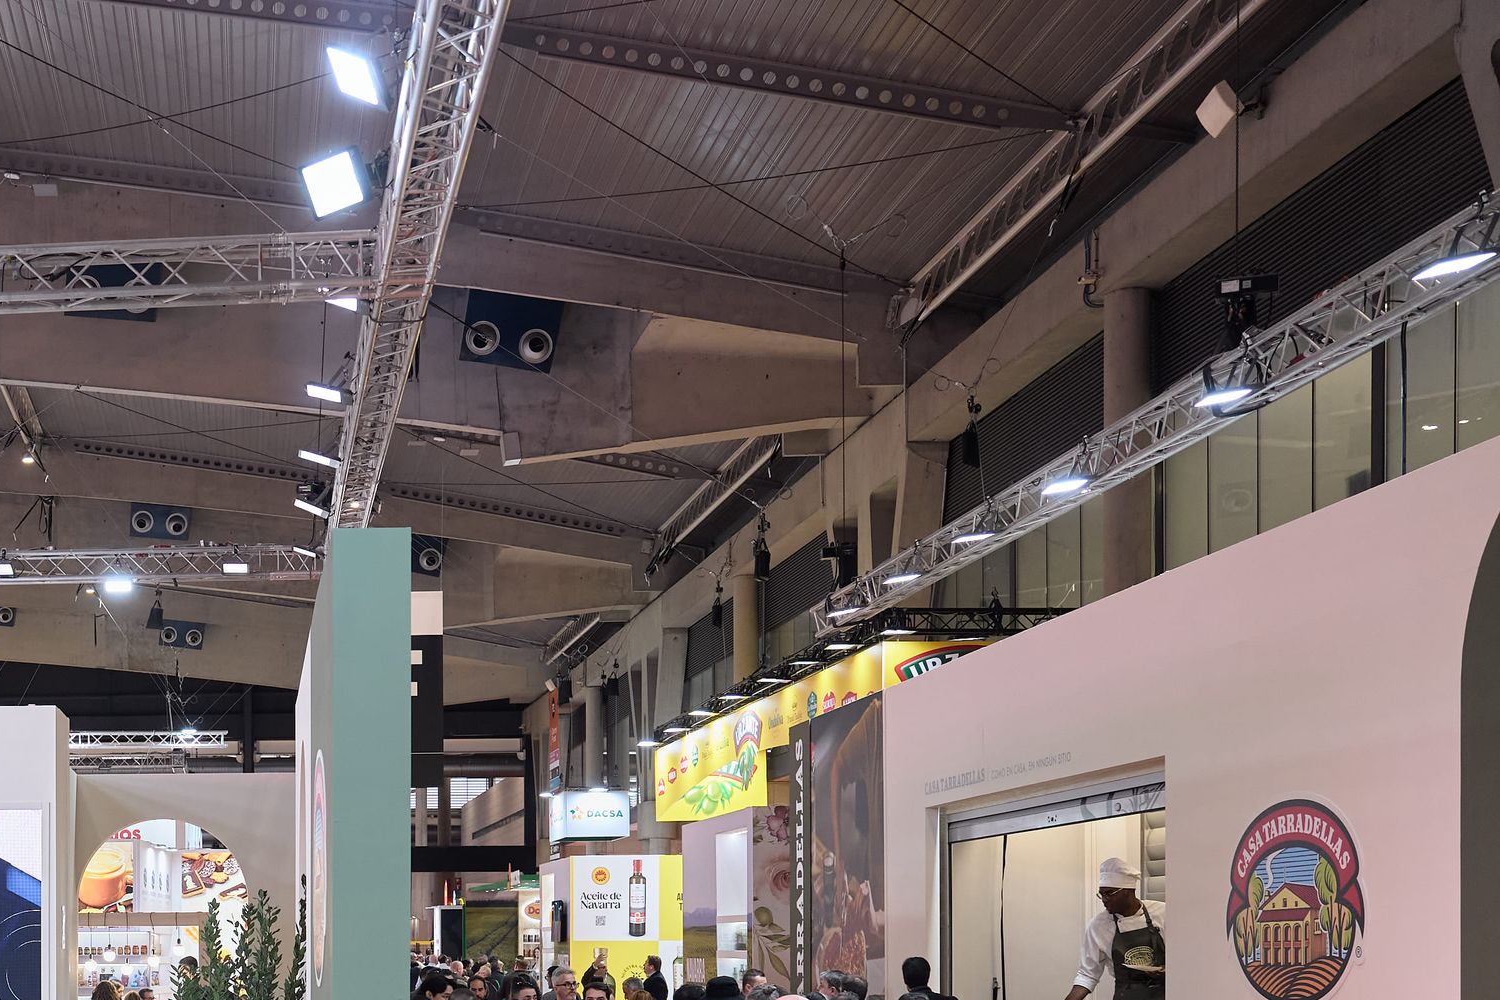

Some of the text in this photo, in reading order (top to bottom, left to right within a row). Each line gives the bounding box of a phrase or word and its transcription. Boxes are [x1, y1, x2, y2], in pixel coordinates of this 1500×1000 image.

[924, 779, 940, 796] CASA
[939, 768, 985, 793] TARRADELLAS
[587, 809, 624, 818] DACSA
[1237, 812, 1351, 879] CASA TARRADELLAS
[795, 738, 805, 996] ARRADELLAS
[580, 891, 609, 901] Aceite
[610, 891, 622, 901] de
[580, 900, 621, 910] Navarra
